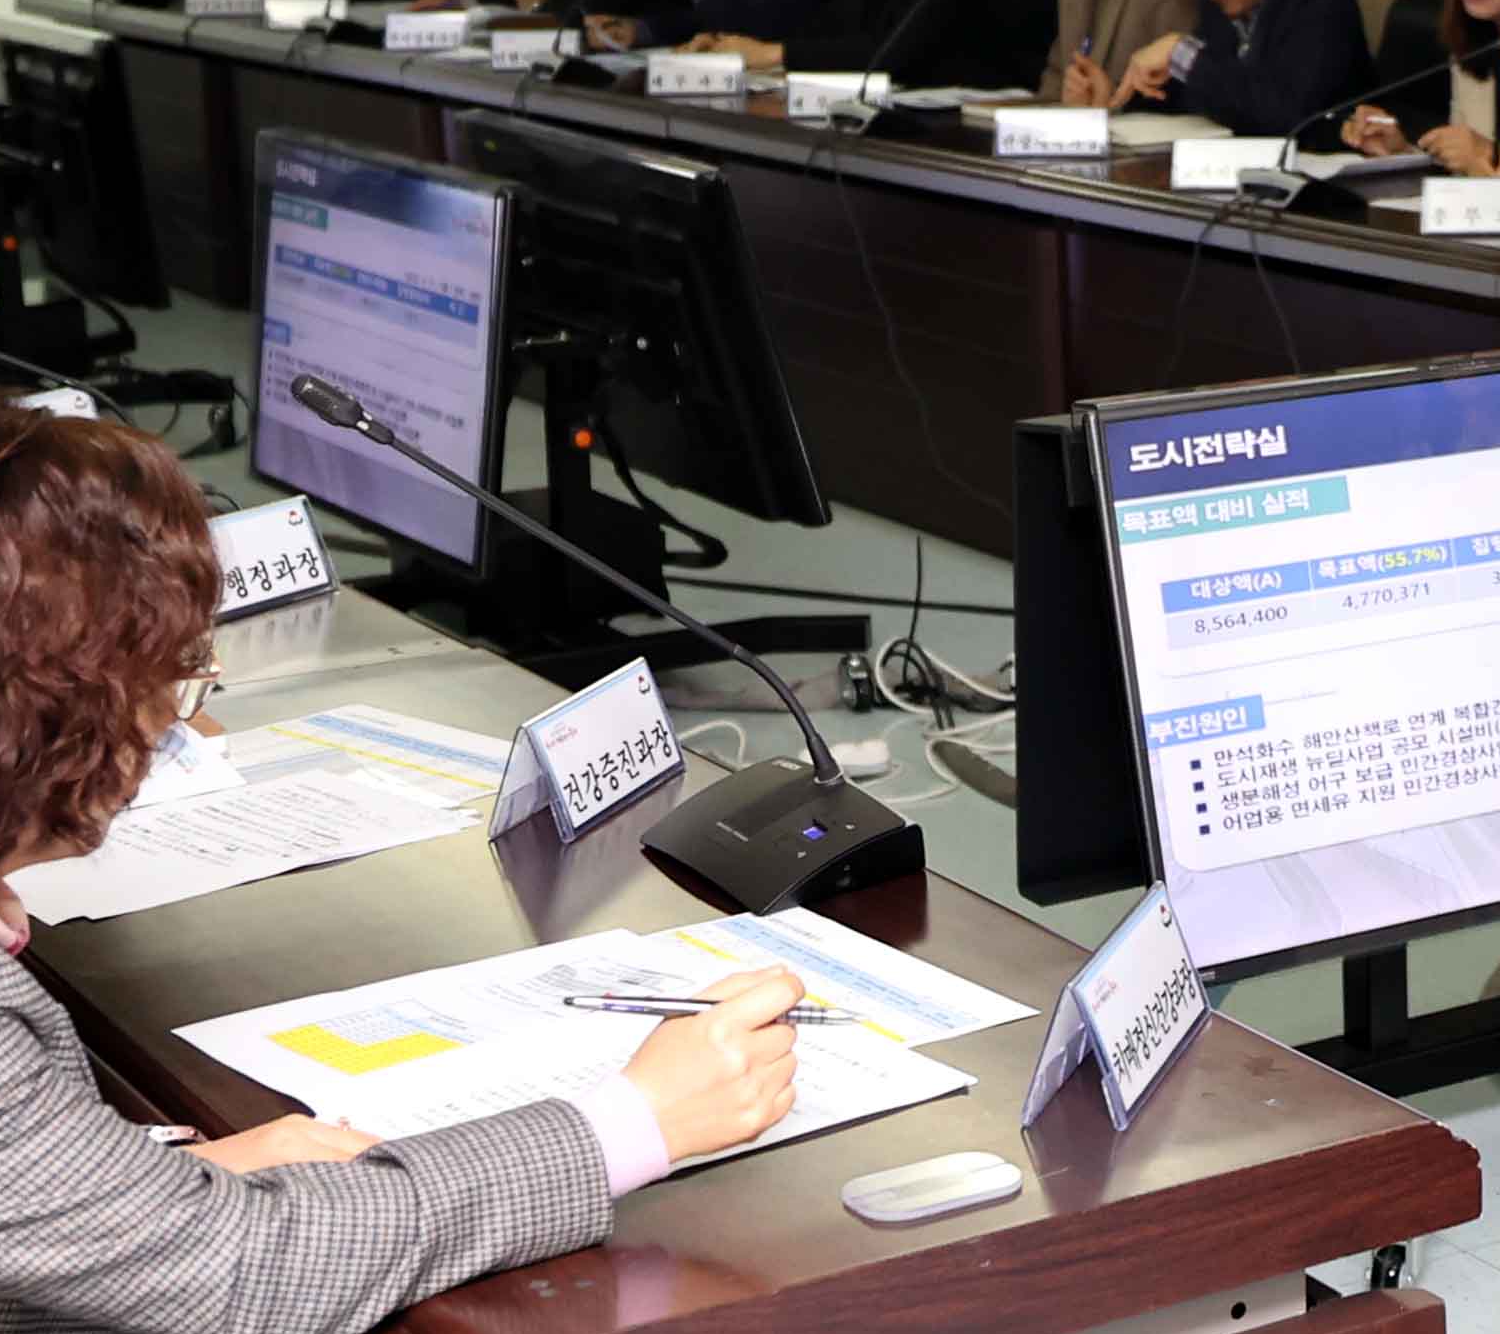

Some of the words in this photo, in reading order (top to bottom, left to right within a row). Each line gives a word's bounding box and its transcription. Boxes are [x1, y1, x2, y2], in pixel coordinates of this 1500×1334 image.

[1129, 425, 1288, 472] 도시전략실
[1122, 501, 1199, 534] 목표액
[1204, 495, 1254, 523] 대비
[1261, 487, 1311, 516] 실적
[225, 547, 320, 599] 행정과장
[1189, 570, 1283, 601] 대상액(A)
[1317, 545, 1447, 580] 목표액(55.7%)
[1193, 605, 1289, 635] 8,564,400
[1341, 581, 1431, 610] 4,770,371
[1148, 704, 1248, 745] 부진원인
[1213, 737, 1296, 769] 만석화수
[1302, 717, 1401, 750] 해안산책로
[1407, 708, 1446, 732] 연계
[563, 719, 673, 813] 건강증진과장
[1216, 756, 1299, 789] 도시재생
[1305, 743, 1384, 773] 뉴딜사업
[1391, 733, 1429, 755] 공모
[1220, 777, 1301, 812] 생분해성
[1308, 769, 1348, 793] 어구
[1355, 761, 1395, 783] 보급
[1222, 805, 1285, 833] 어업용
[1291, 791, 1351, 820] 면세유
[1358, 782, 1396, 805] 지원
[1112, 957, 1197, 1084] 치매정신건강과장
